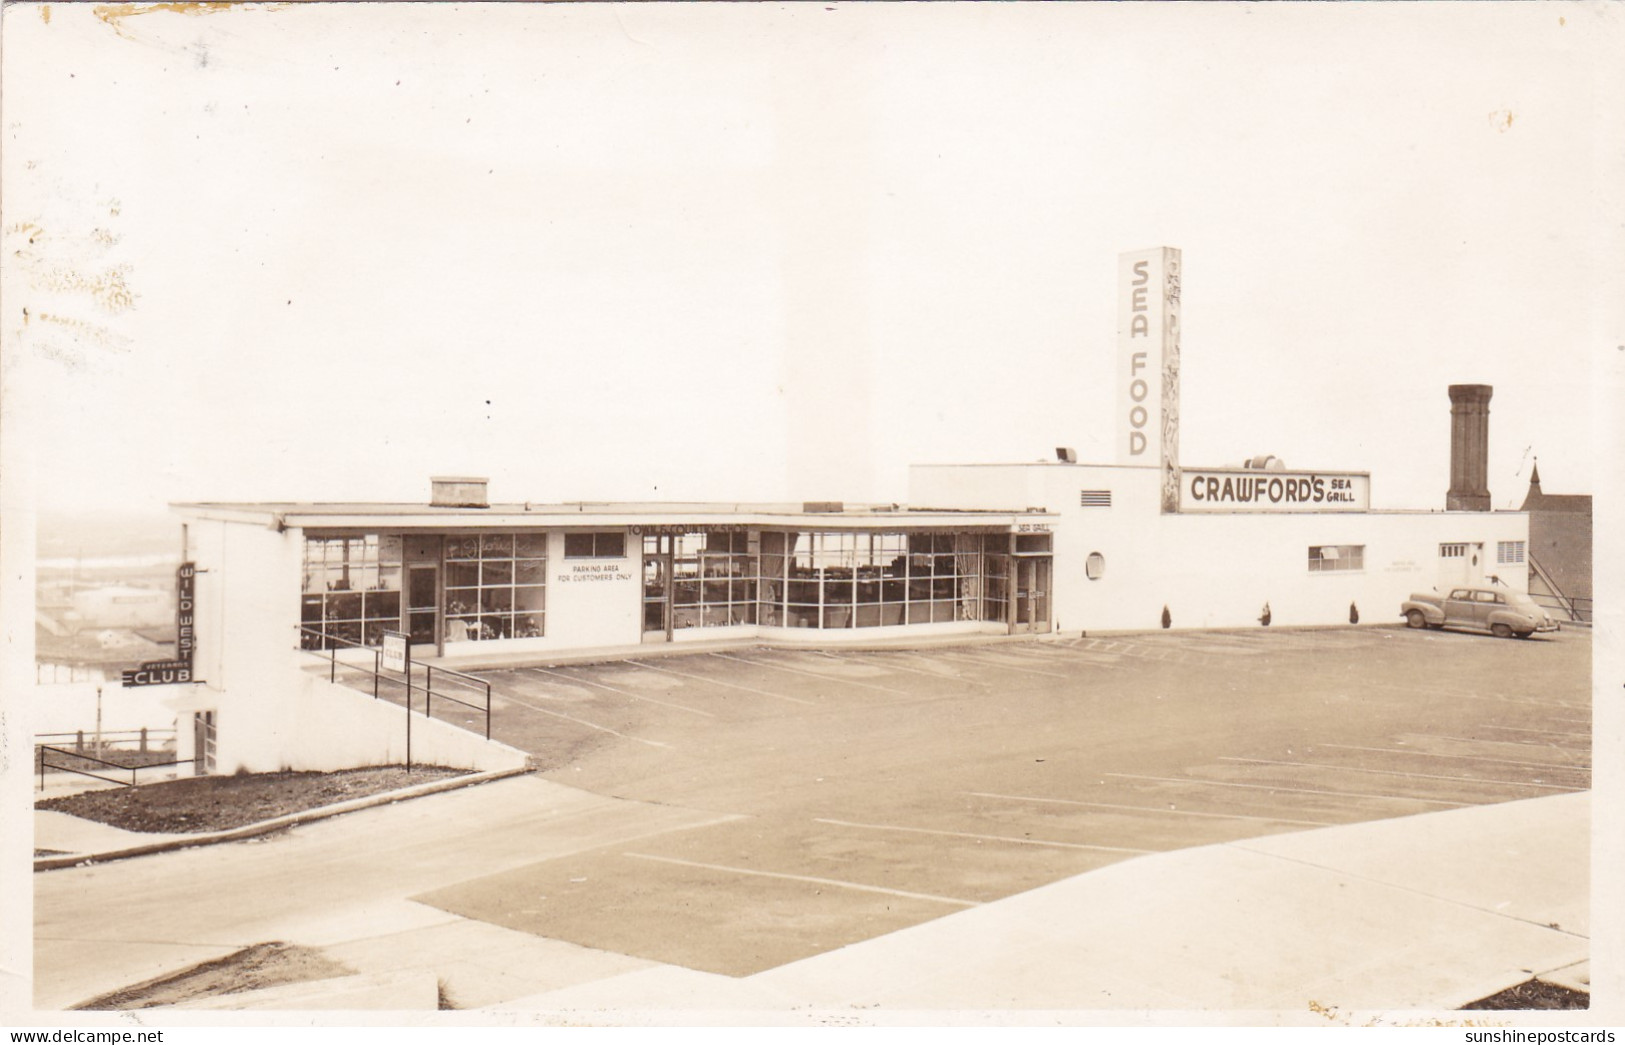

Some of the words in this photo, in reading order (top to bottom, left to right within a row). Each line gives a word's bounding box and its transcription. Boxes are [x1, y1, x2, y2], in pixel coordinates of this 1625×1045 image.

[1131, 260, 1149, 338] SEA
[1129, 352, 1148, 456] FOOD
[1191, 475, 1325, 503] CRAWFORD'S
[1331, 479, 1352, 489] SEA
[1326, 491, 1355, 502] GRILL
[573, 565, 601, 573] PARKING
[573, 574, 613, 582] CUSTOMERS
[616, 573, 632, 581] ONLY
[180, 567, 193, 611] WILD
[180, 615, 193, 660] WEST
[134, 669, 190, 685] CLUB
